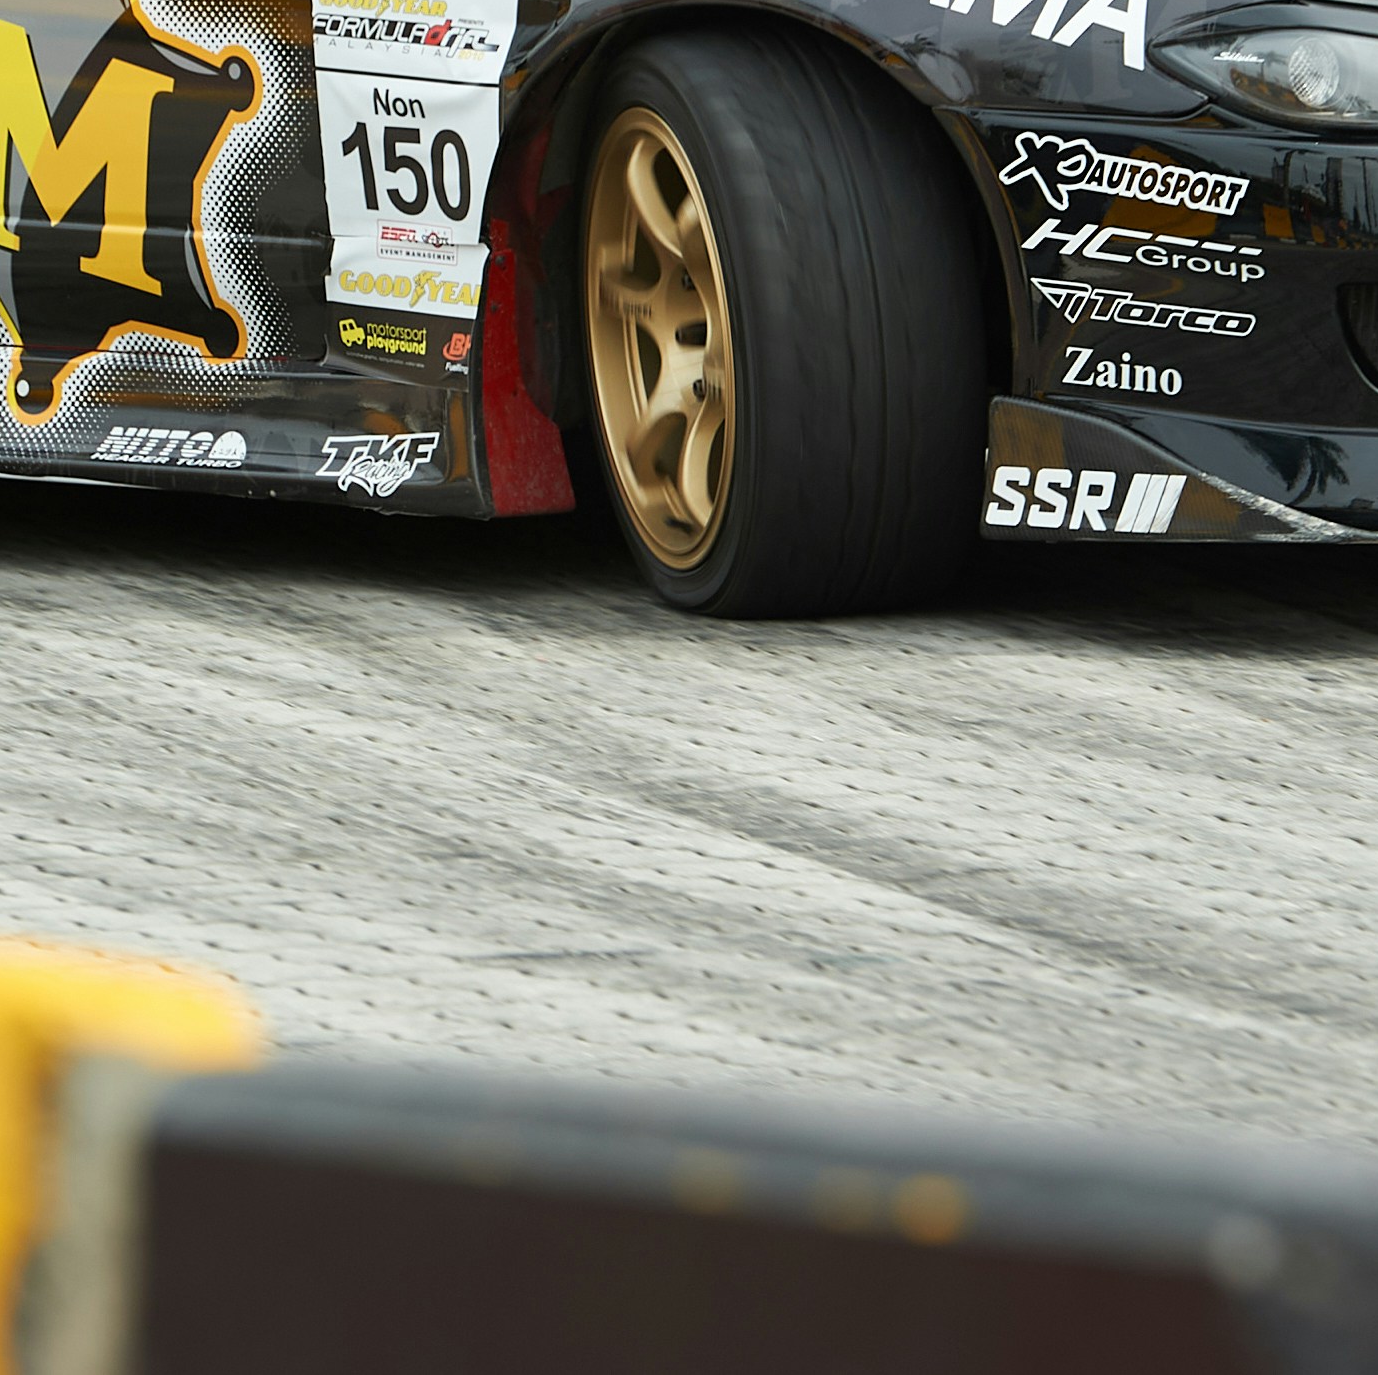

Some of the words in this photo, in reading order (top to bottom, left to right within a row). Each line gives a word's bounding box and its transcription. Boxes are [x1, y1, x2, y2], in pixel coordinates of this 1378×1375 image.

[372, 87, 426, 120] Non
[341, 121, 472, 222] 150
[1085, 156, 1250, 216] AUTOSPORT
[1135, 245, 1266, 282] Group
[366, 321, 427, 343] motorsport
[1090, 288, 1256, 336] Torco
[366, 334, 426, 356] playground
[1061, 345, 1184, 396] Zaino
[90, 452, 170, 464] HEADER
[176, 458, 242, 468] TURBO
[96, 426, 215, 458] NITTO
[315, 432, 440, 477] TKF
[985, 465, 1117, 532] SSR
